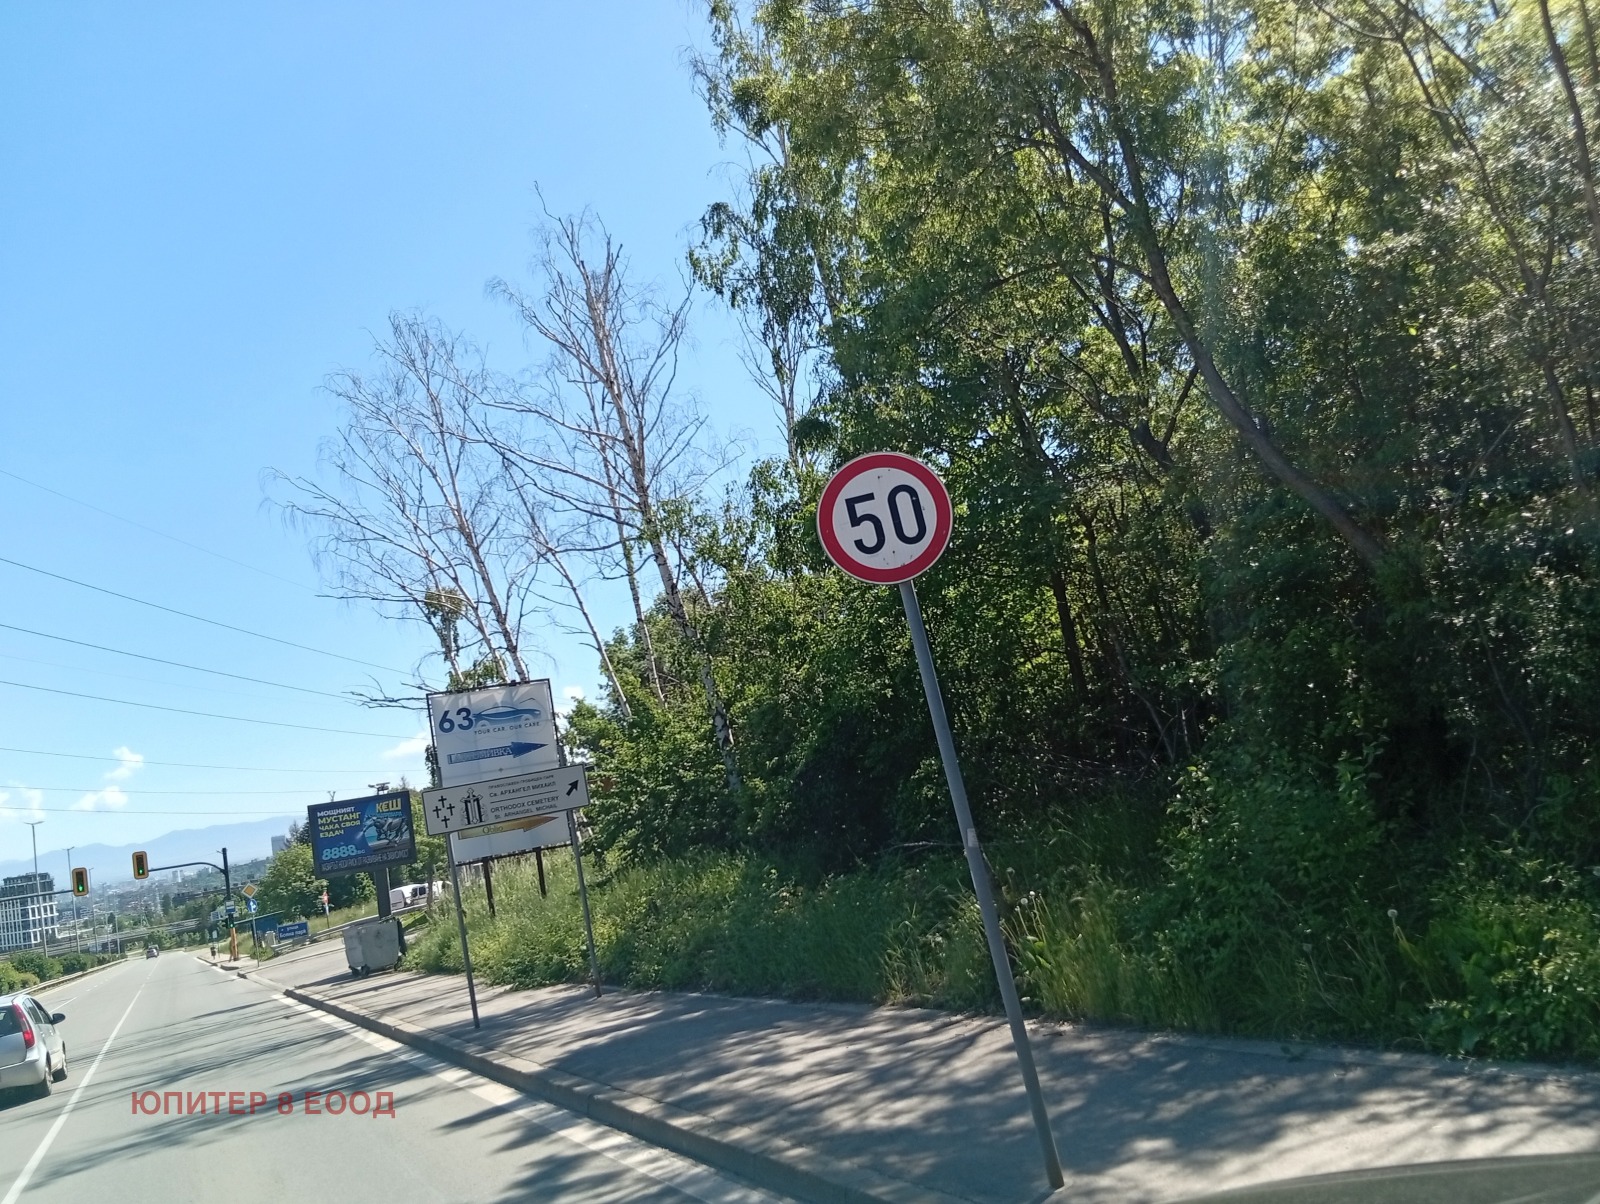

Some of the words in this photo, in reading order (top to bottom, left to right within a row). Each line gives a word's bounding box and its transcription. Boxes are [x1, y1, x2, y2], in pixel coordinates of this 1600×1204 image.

[845, 484, 927, 555] 50
[438, 707, 474, 734] 63
[500, 785, 531, 796] АРХАНГЕЛ
[532, 780, 557, 790] МИХАИЛ
[317, 806, 355, 817] МОЩНИЯТ
[375, 798, 402, 813] КЕШ
[490, 801, 525, 814] ORTHODOX
[526, 796, 559, 807] CEMETERY
[317, 811, 361, 825] МУСТАНГ
[504, 808, 534, 818] ARHANGEL
[318, 823, 340, 832] ЧАКА
[319, 829, 344, 838] ЕЗДАЧ
